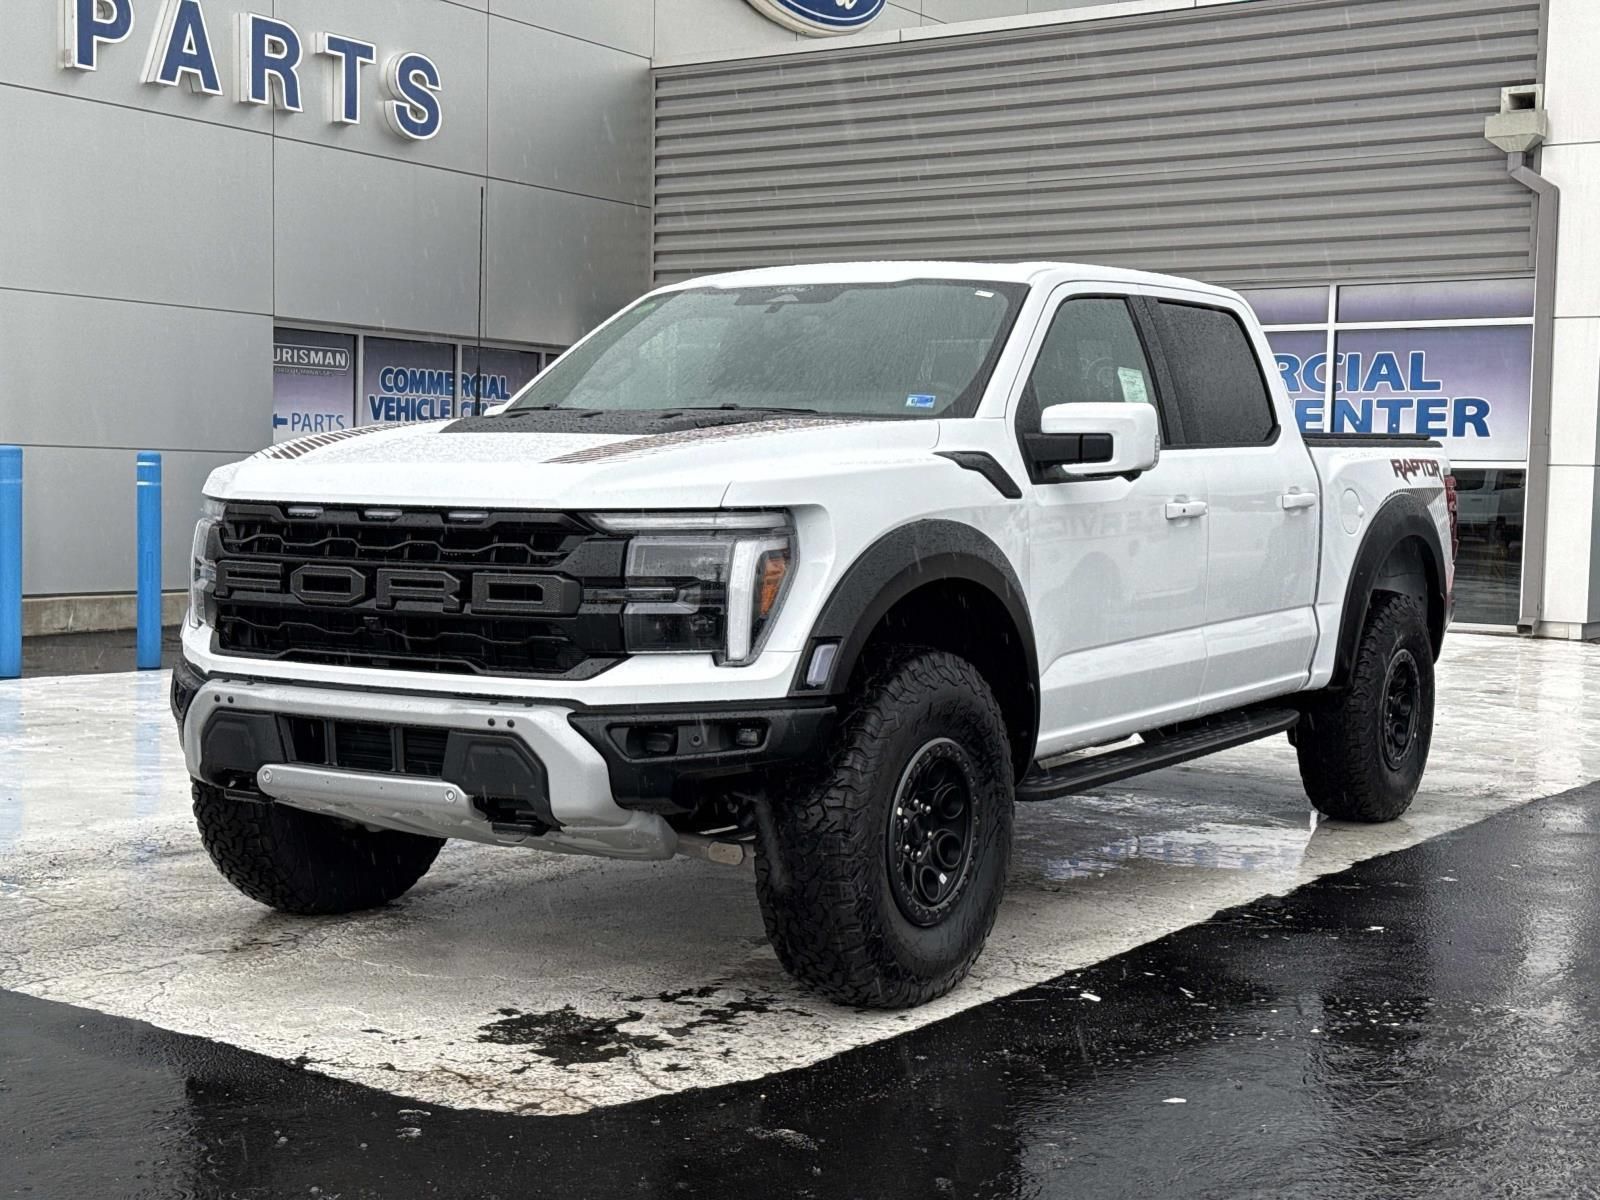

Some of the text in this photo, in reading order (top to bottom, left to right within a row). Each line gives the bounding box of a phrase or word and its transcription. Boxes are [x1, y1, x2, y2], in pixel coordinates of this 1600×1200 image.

[64, 0, 443, 140] PARTS
[291, 412, 345, 432] PARTS
[368, 394, 450, 421] VEHICLE
[1291, 397, 1491, 437] ENTER
[1390, 459, 1444, 485] RAPTOR
[215, 560, 584, 614] FORD
